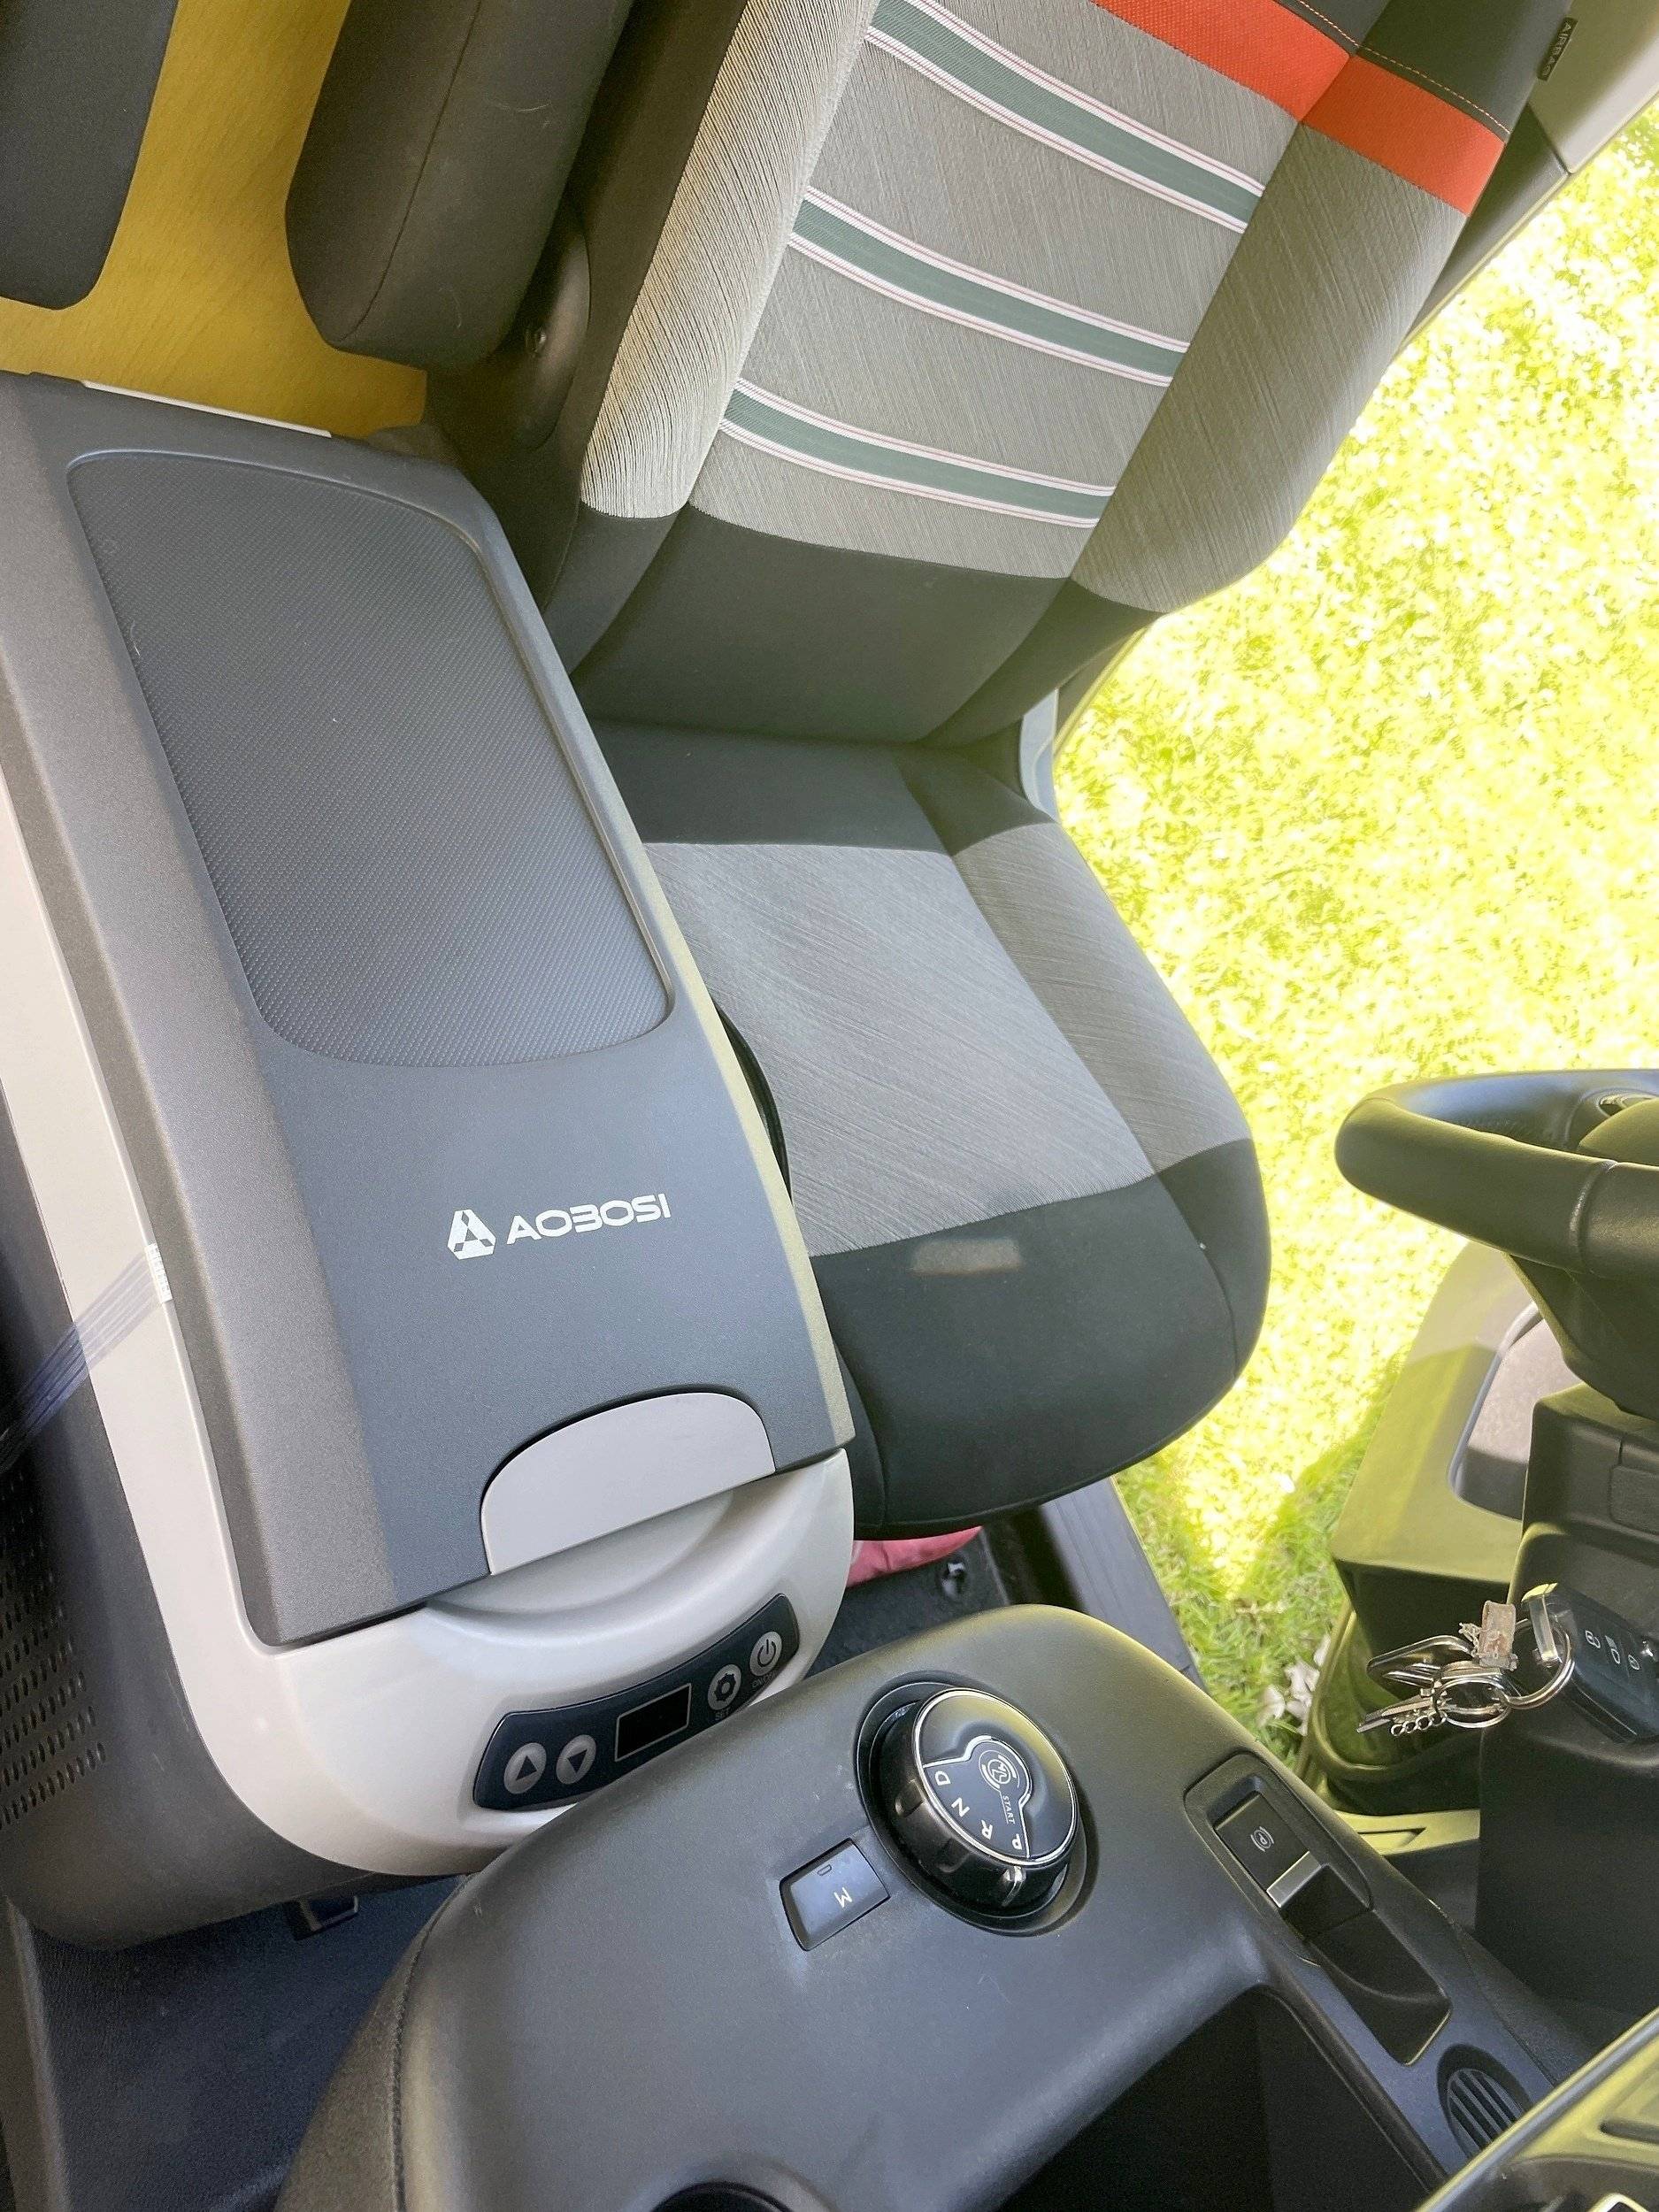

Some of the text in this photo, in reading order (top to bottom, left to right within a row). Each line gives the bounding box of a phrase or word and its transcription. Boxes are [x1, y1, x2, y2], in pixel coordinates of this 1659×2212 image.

[507, 1194, 671, 1245] AOBOSI
[934, 1770, 1023, 1850] P R N D
[1002, 1795, 1015, 1824] START
